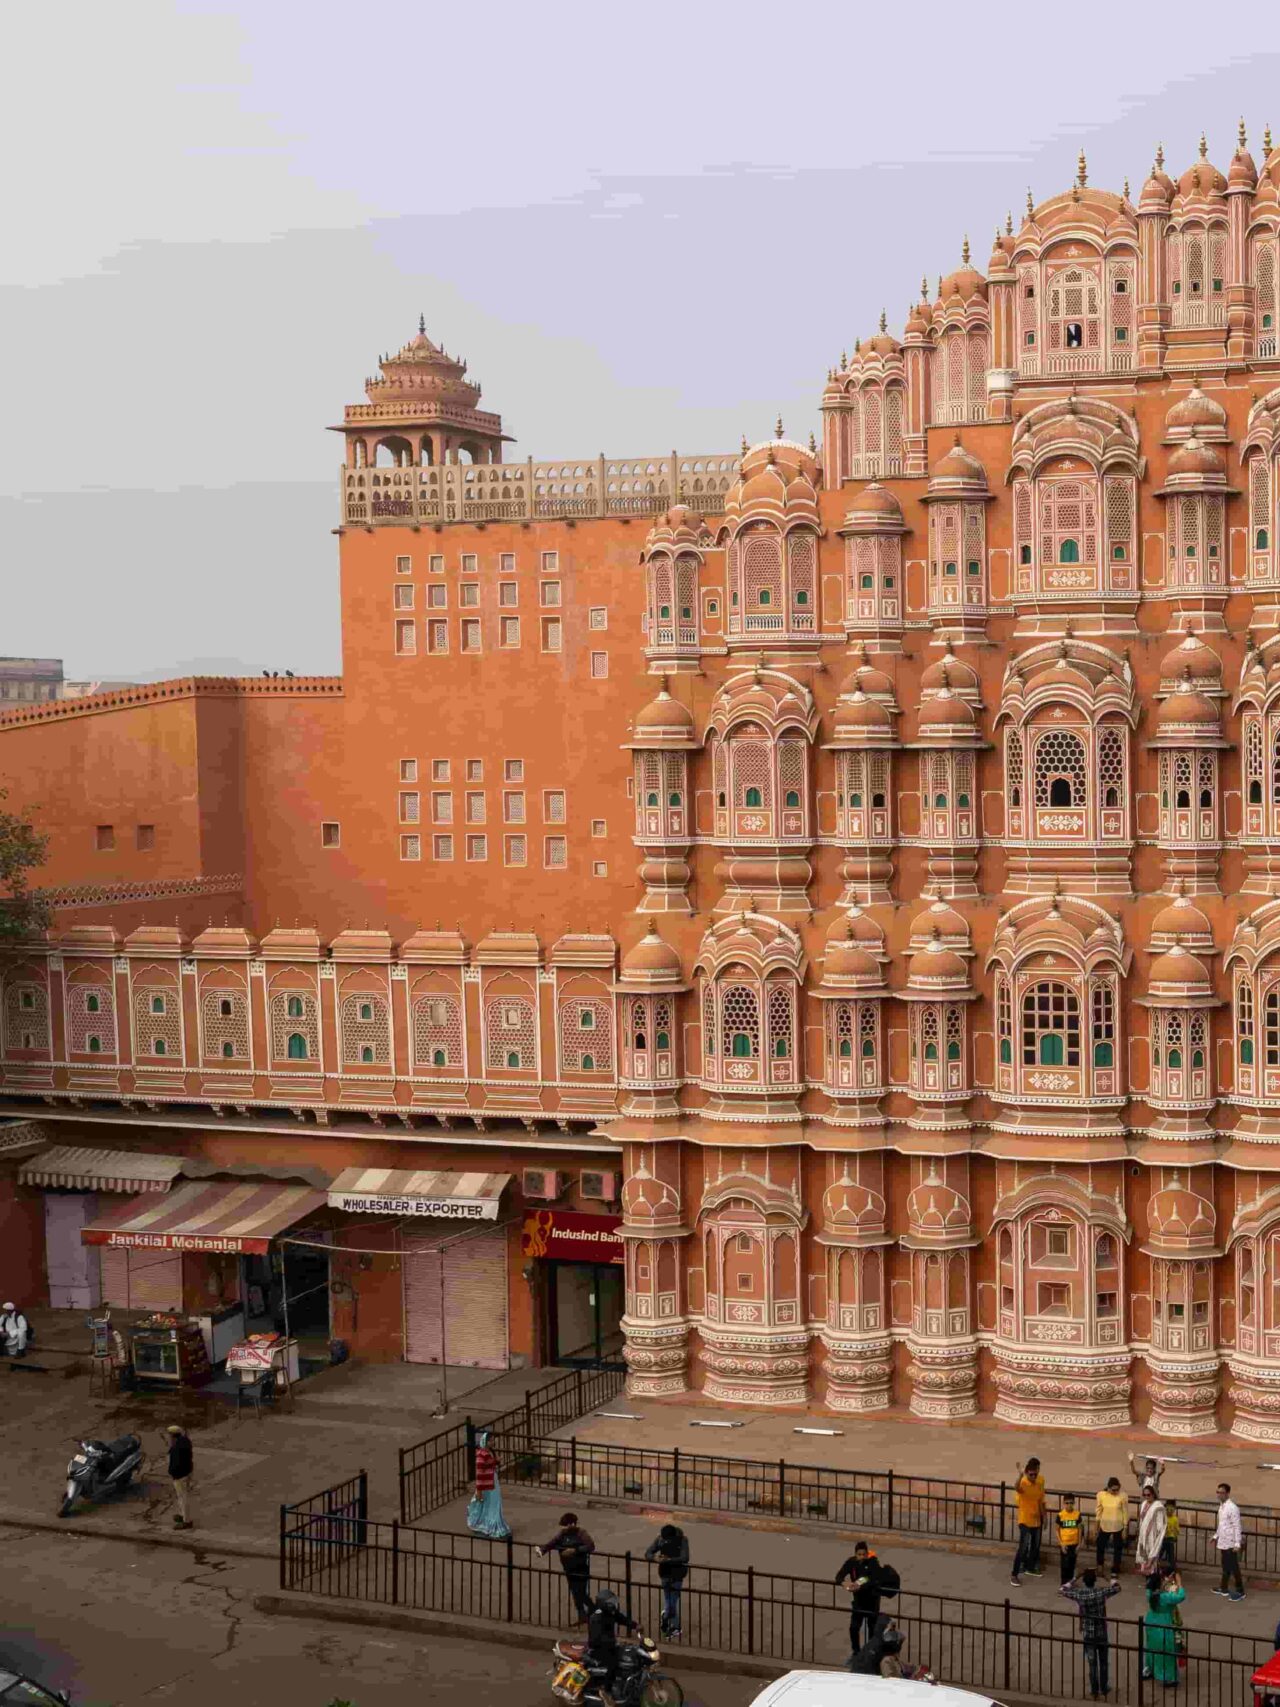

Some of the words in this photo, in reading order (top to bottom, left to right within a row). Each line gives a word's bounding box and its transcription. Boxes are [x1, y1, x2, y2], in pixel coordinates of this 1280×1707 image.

[342, 1199, 410, 1212] WHOLESALER
[415, 1202, 484, 1217] EXPORTER
[107, 1233, 167, 1247] Jankilal
[171, 1235, 243, 1251] Mohanlal
[551, 1227, 599, 1242] IndusInd
